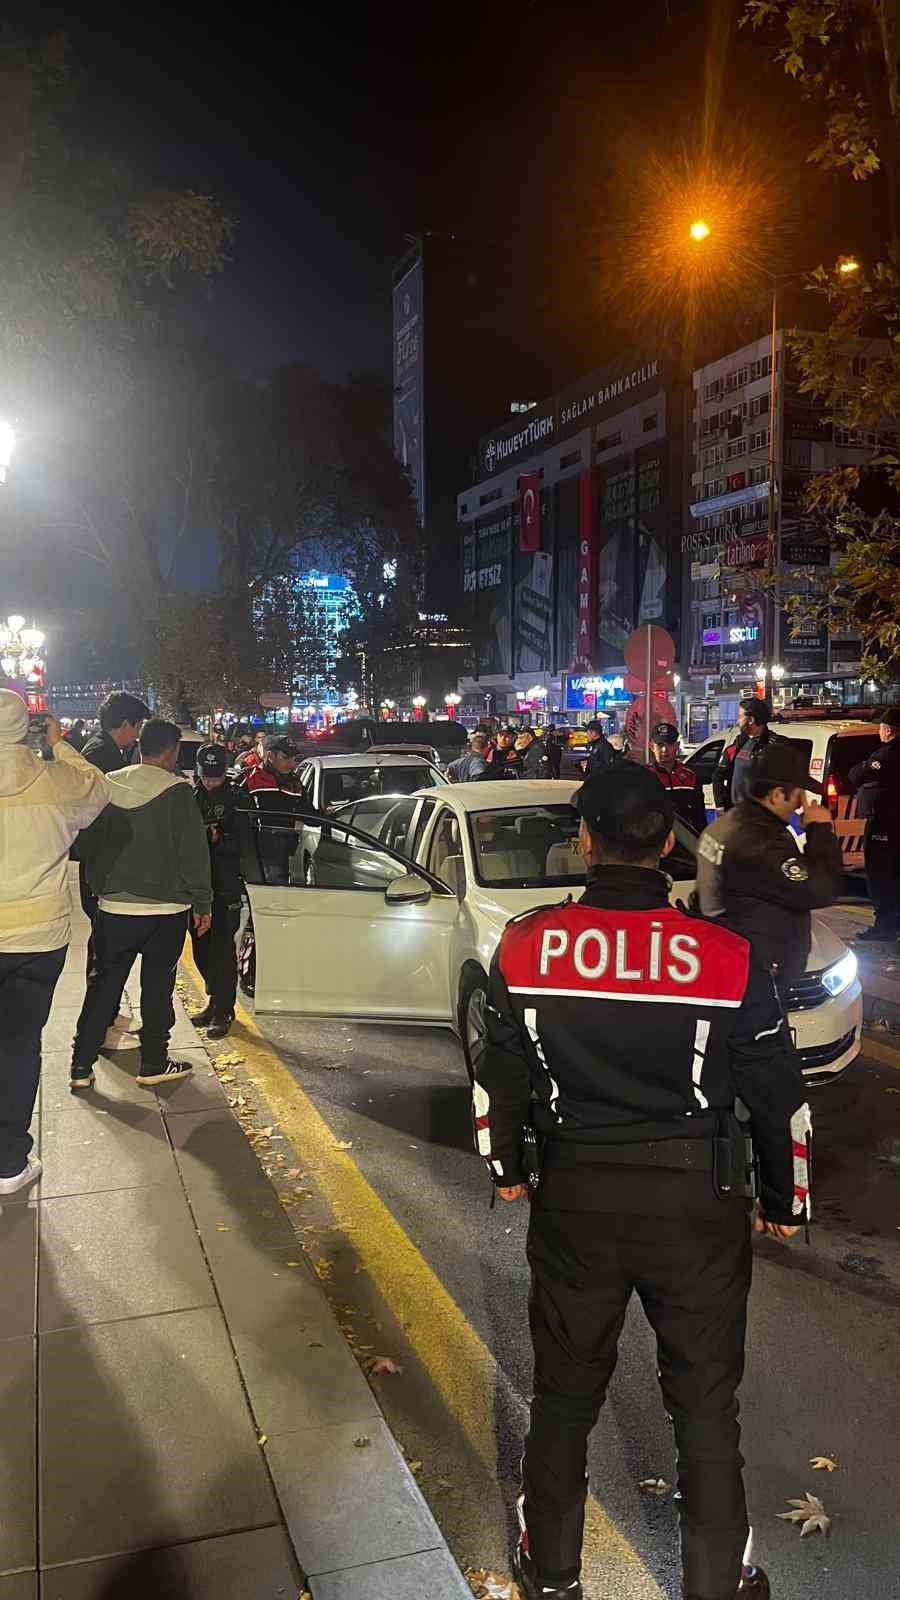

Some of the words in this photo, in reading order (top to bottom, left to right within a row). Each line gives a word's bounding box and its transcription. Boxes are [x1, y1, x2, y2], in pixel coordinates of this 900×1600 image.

[561, 397, 596, 425] SAĞLAM
[598, 359, 659, 404] BANKACILIK
[539, 921, 700, 983] POLİS
